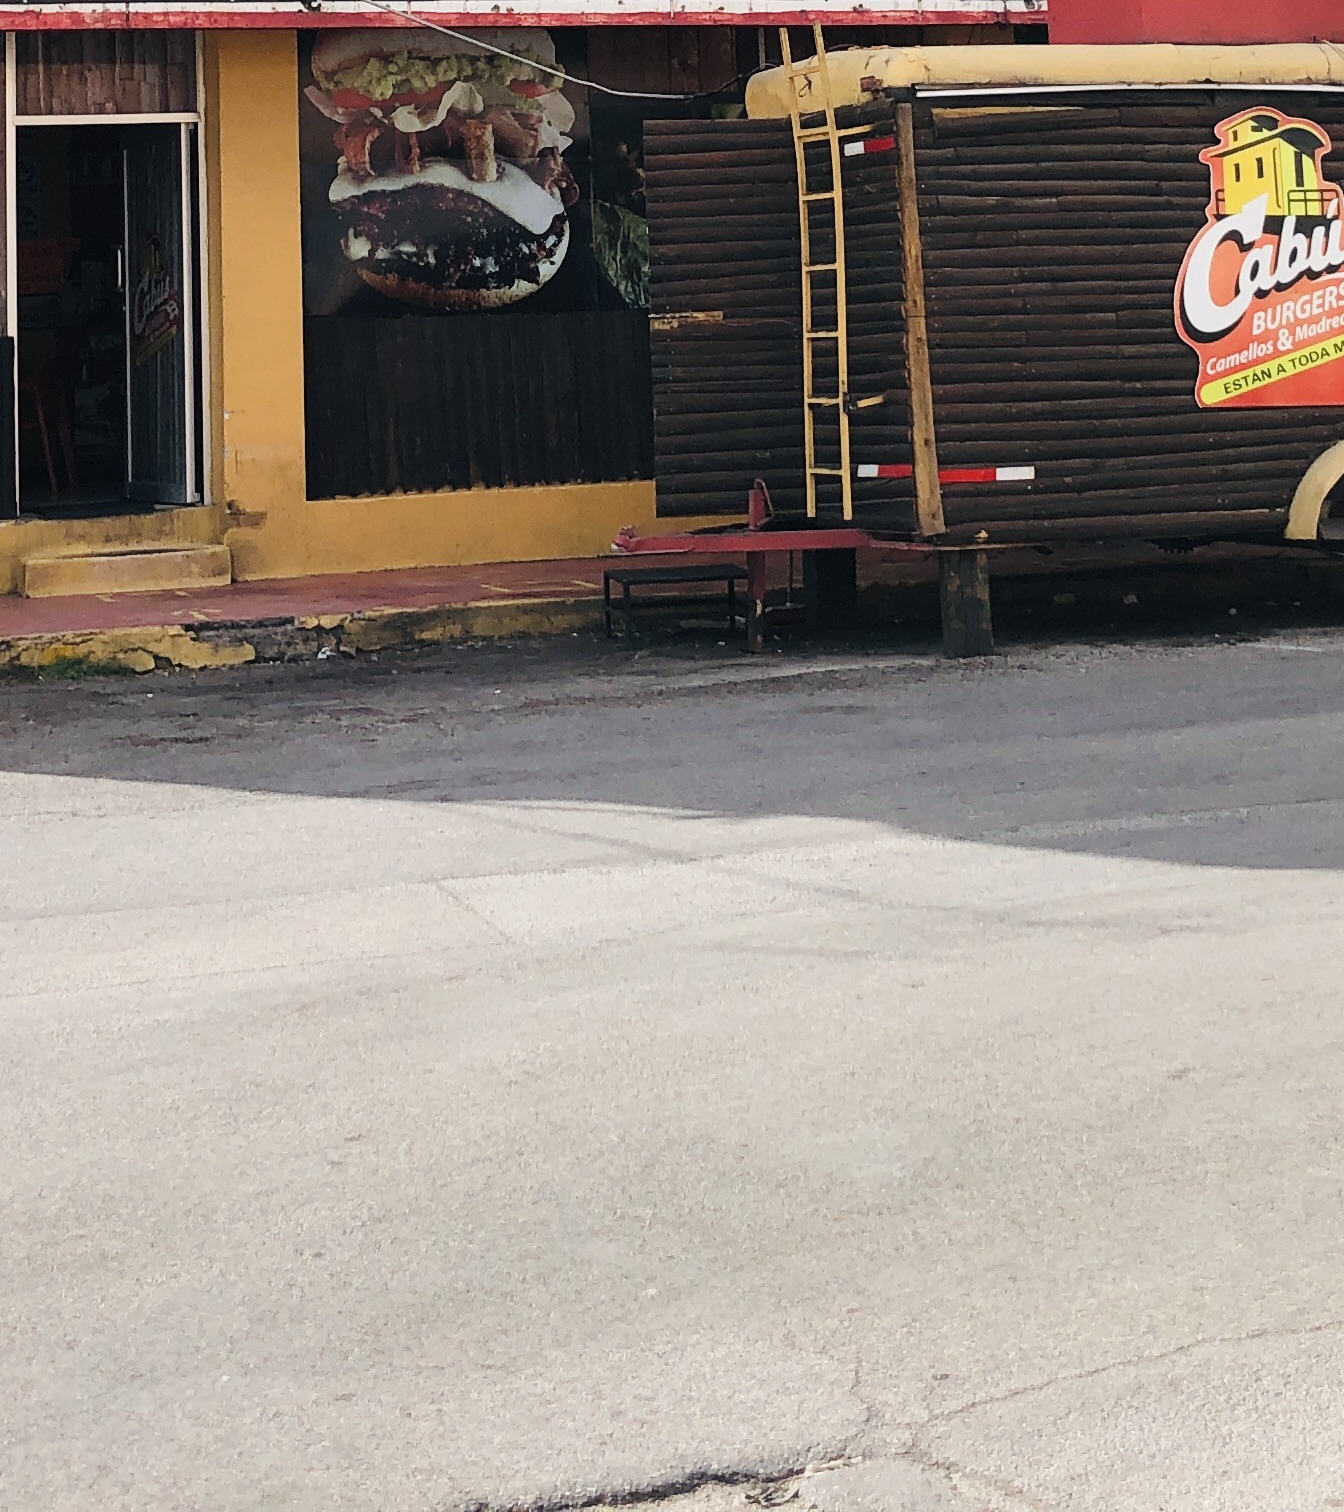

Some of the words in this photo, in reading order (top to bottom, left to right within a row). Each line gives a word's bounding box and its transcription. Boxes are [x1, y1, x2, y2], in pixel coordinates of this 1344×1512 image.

[1206, 340, 1274, 375] Camellos
[1276, 328, 1293, 351] &
[1223, 368, 1273, 396] ESTÁN
[1276, 363, 1287, 376] A
[1288, 346, 1331, 371] TODA
